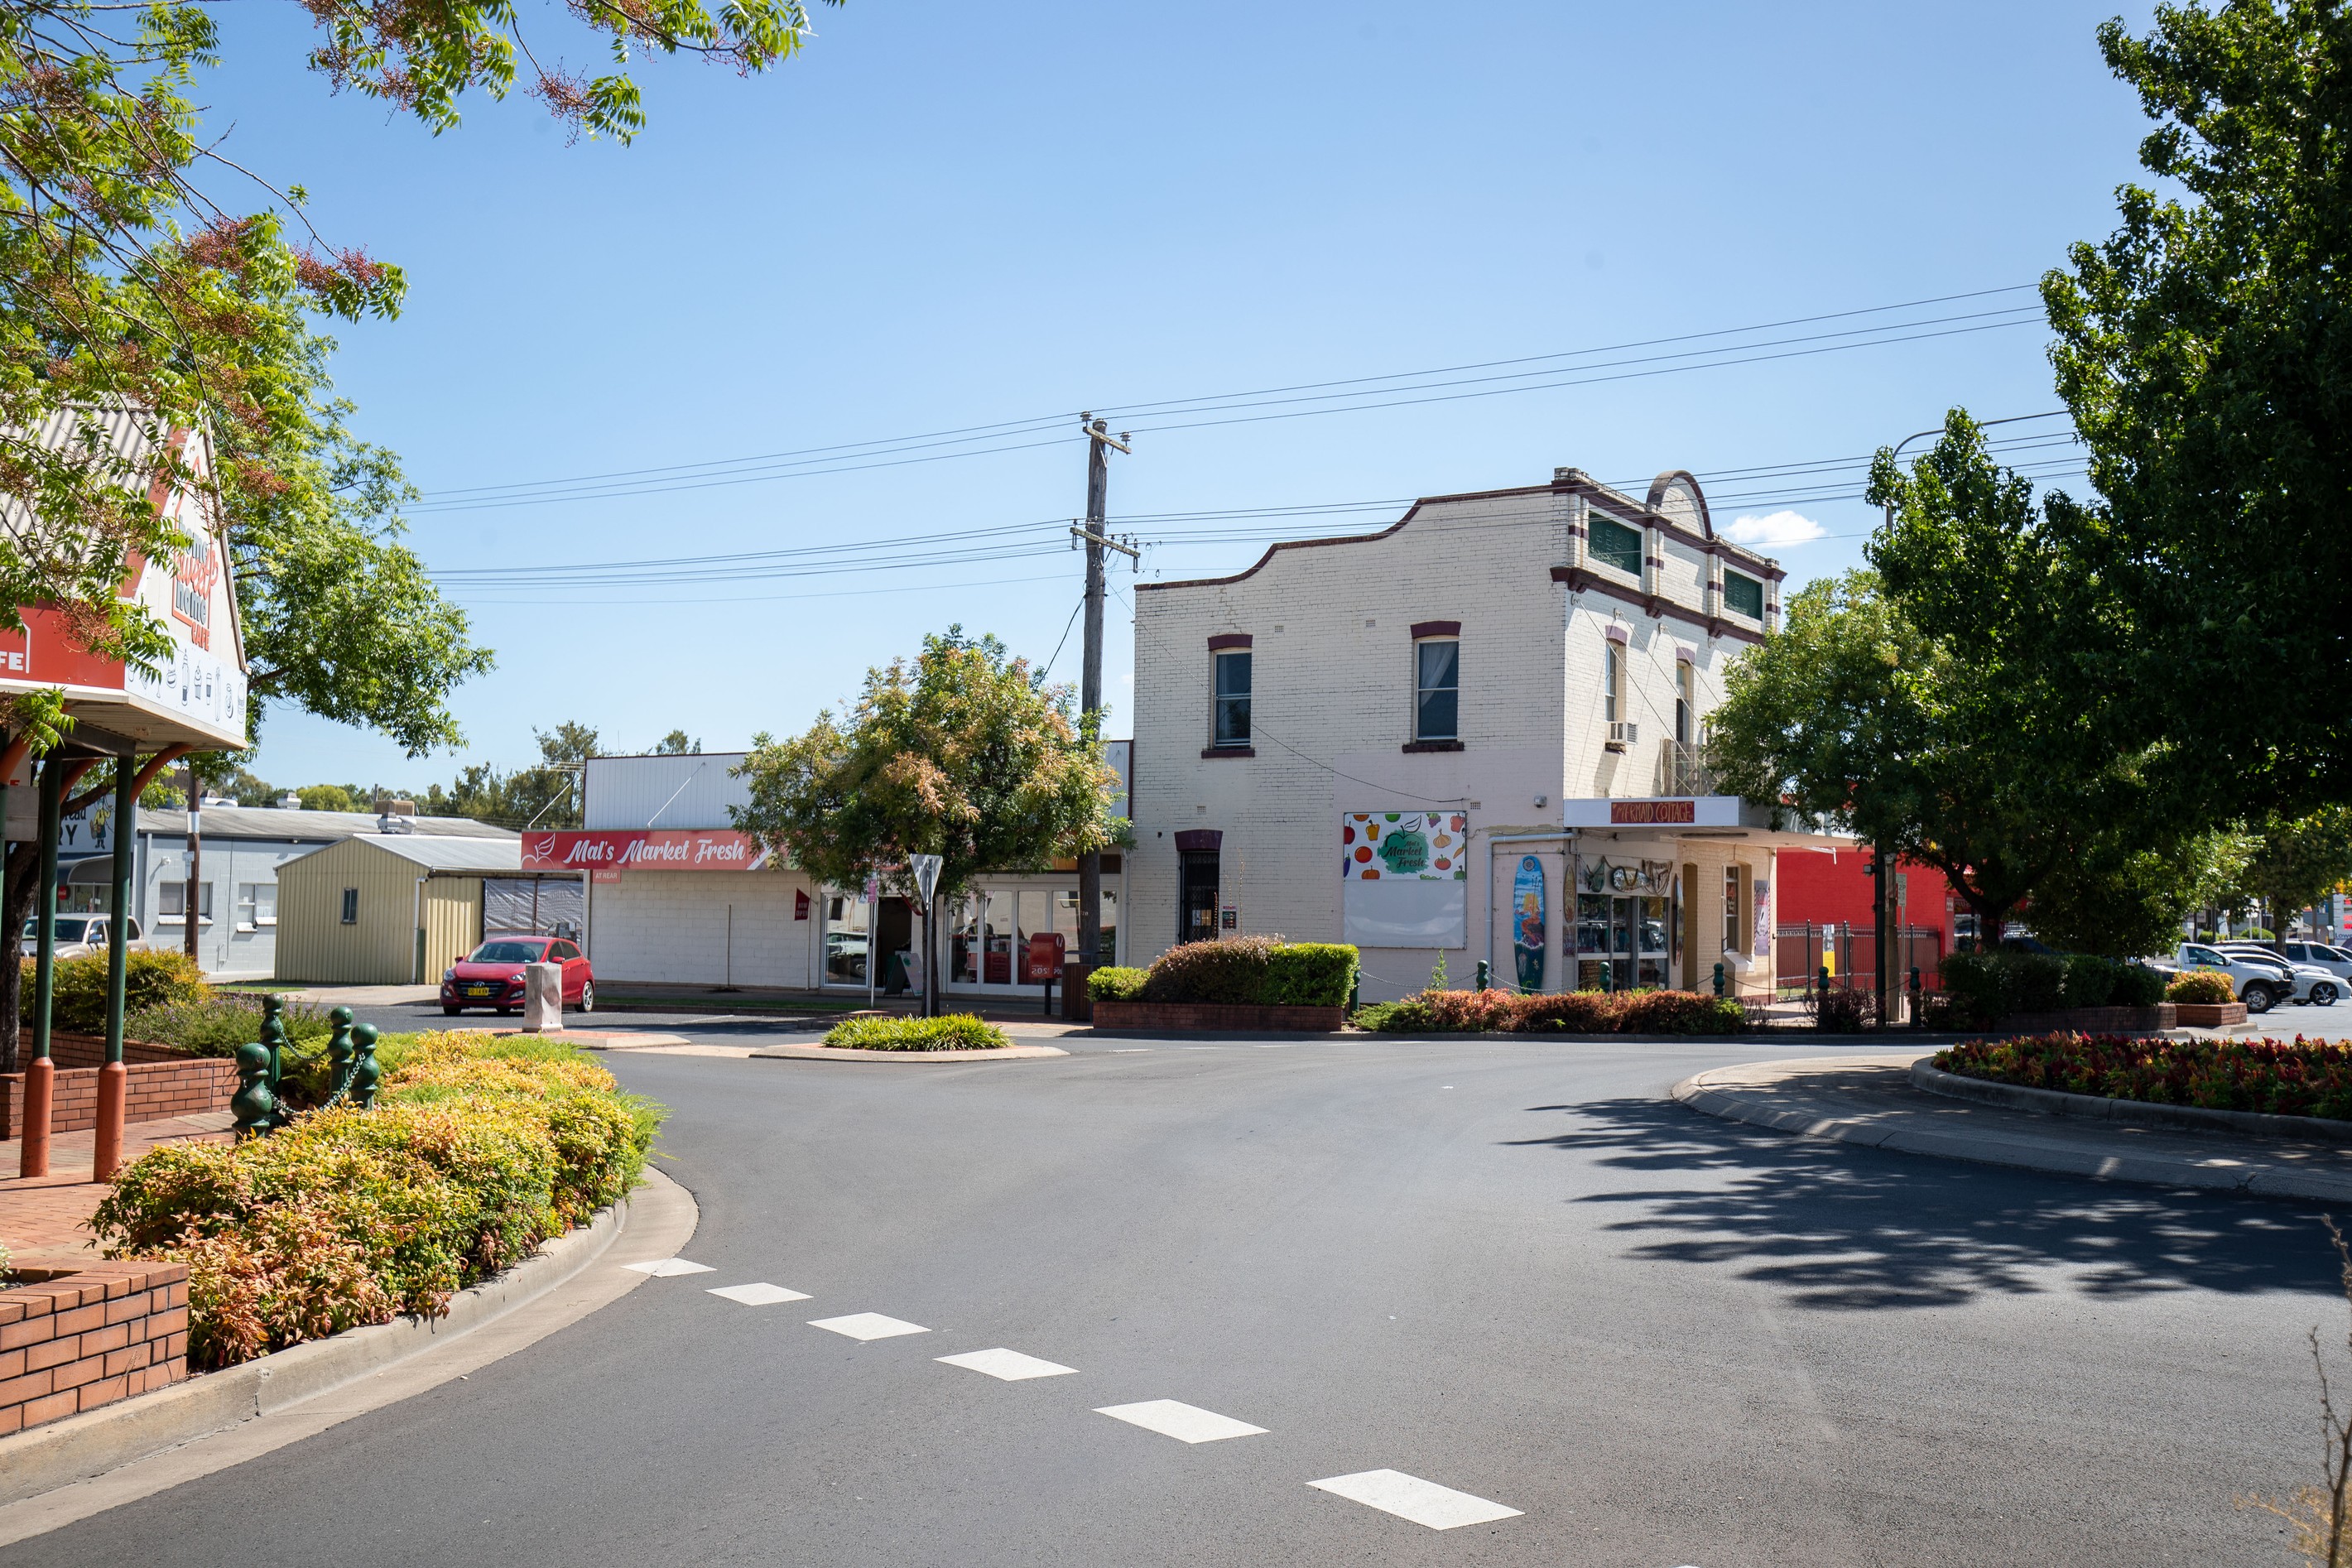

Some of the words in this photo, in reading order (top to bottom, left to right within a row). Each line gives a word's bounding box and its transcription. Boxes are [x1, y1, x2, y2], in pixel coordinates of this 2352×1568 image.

[176, 580, 207, 625] home
[191, 621, 210, 652] CAFE
[1613, 802, 1654, 823] MERMAID
[1656, 802, 1693, 822] COTTAGE
[563, 839, 614, 863] Mal's
[618, 839, 690, 864] Market
[695, 839, 745, 863] Fresh
[1383, 846, 1422, 857] Market
[1397, 858, 1424, 868] Fresh
